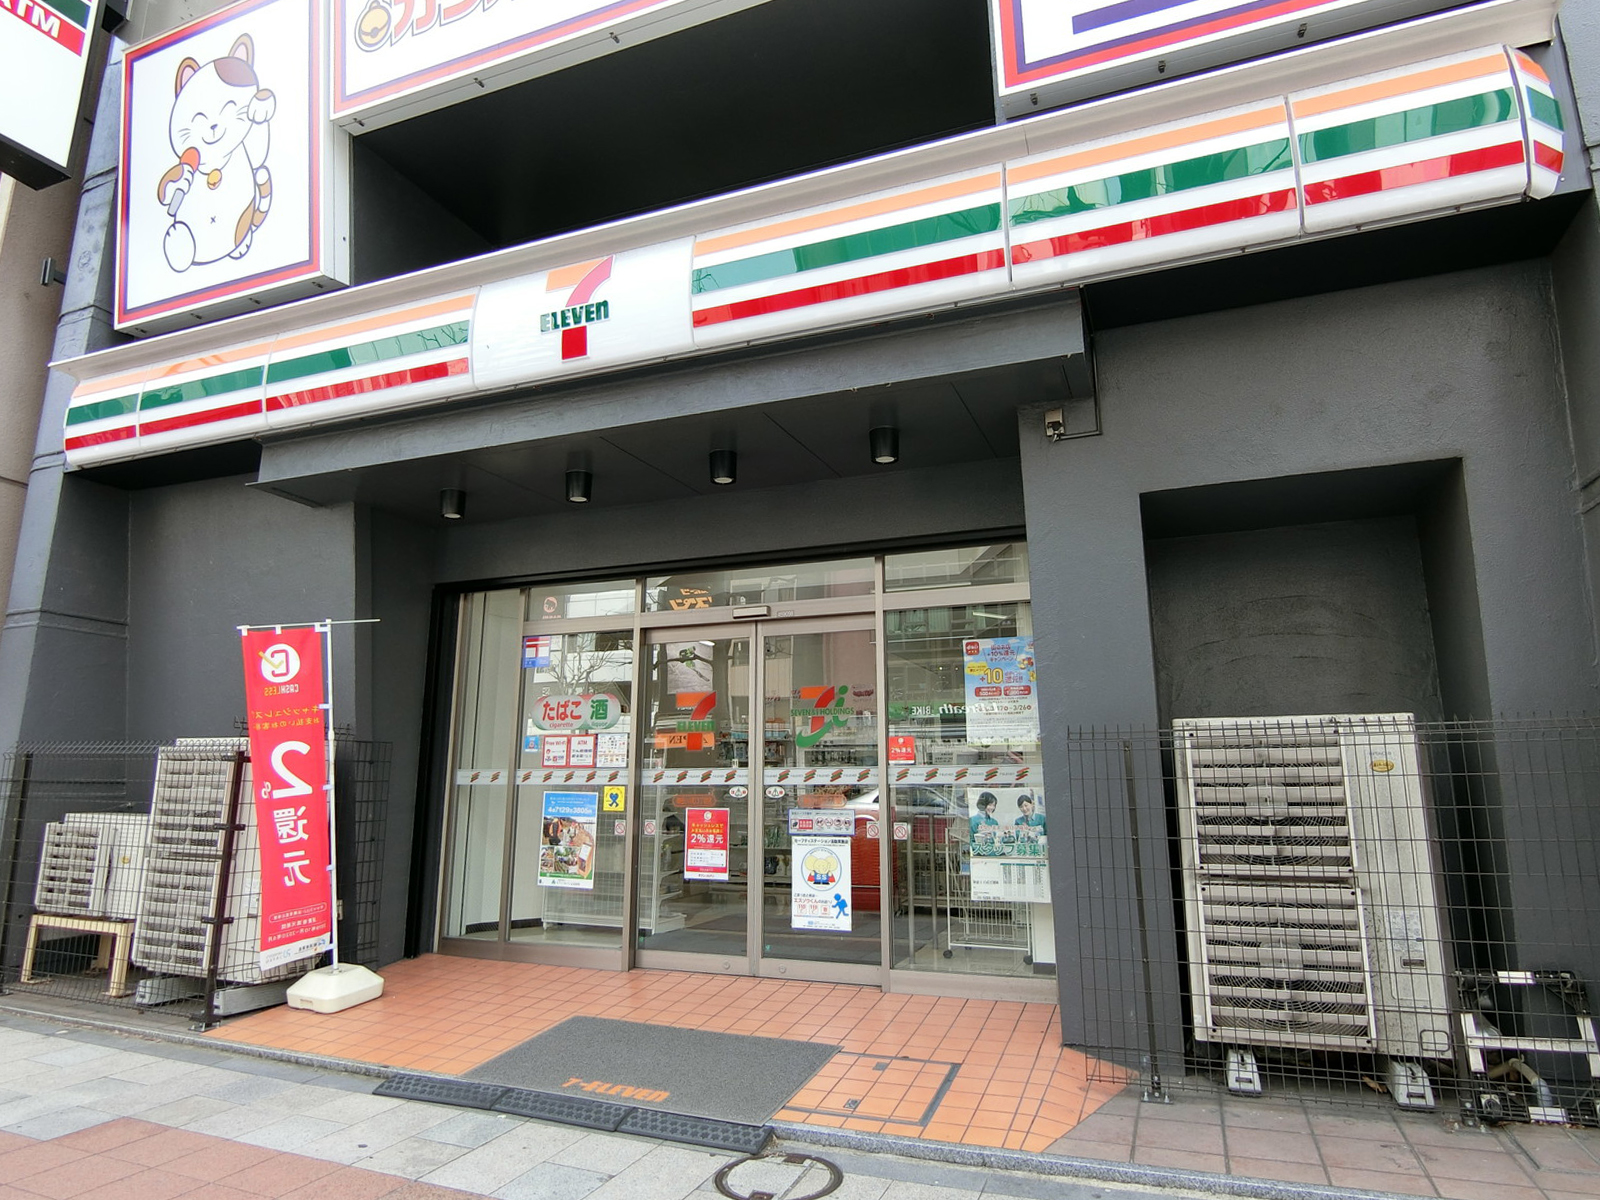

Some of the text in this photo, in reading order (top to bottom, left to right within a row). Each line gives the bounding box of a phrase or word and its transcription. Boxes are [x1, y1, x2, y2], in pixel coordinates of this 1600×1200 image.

[543, 700, 582, 721] たばこ
[590, 699, 609, 720] 酒
[820, 707, 855, 716] HOLDINGS
